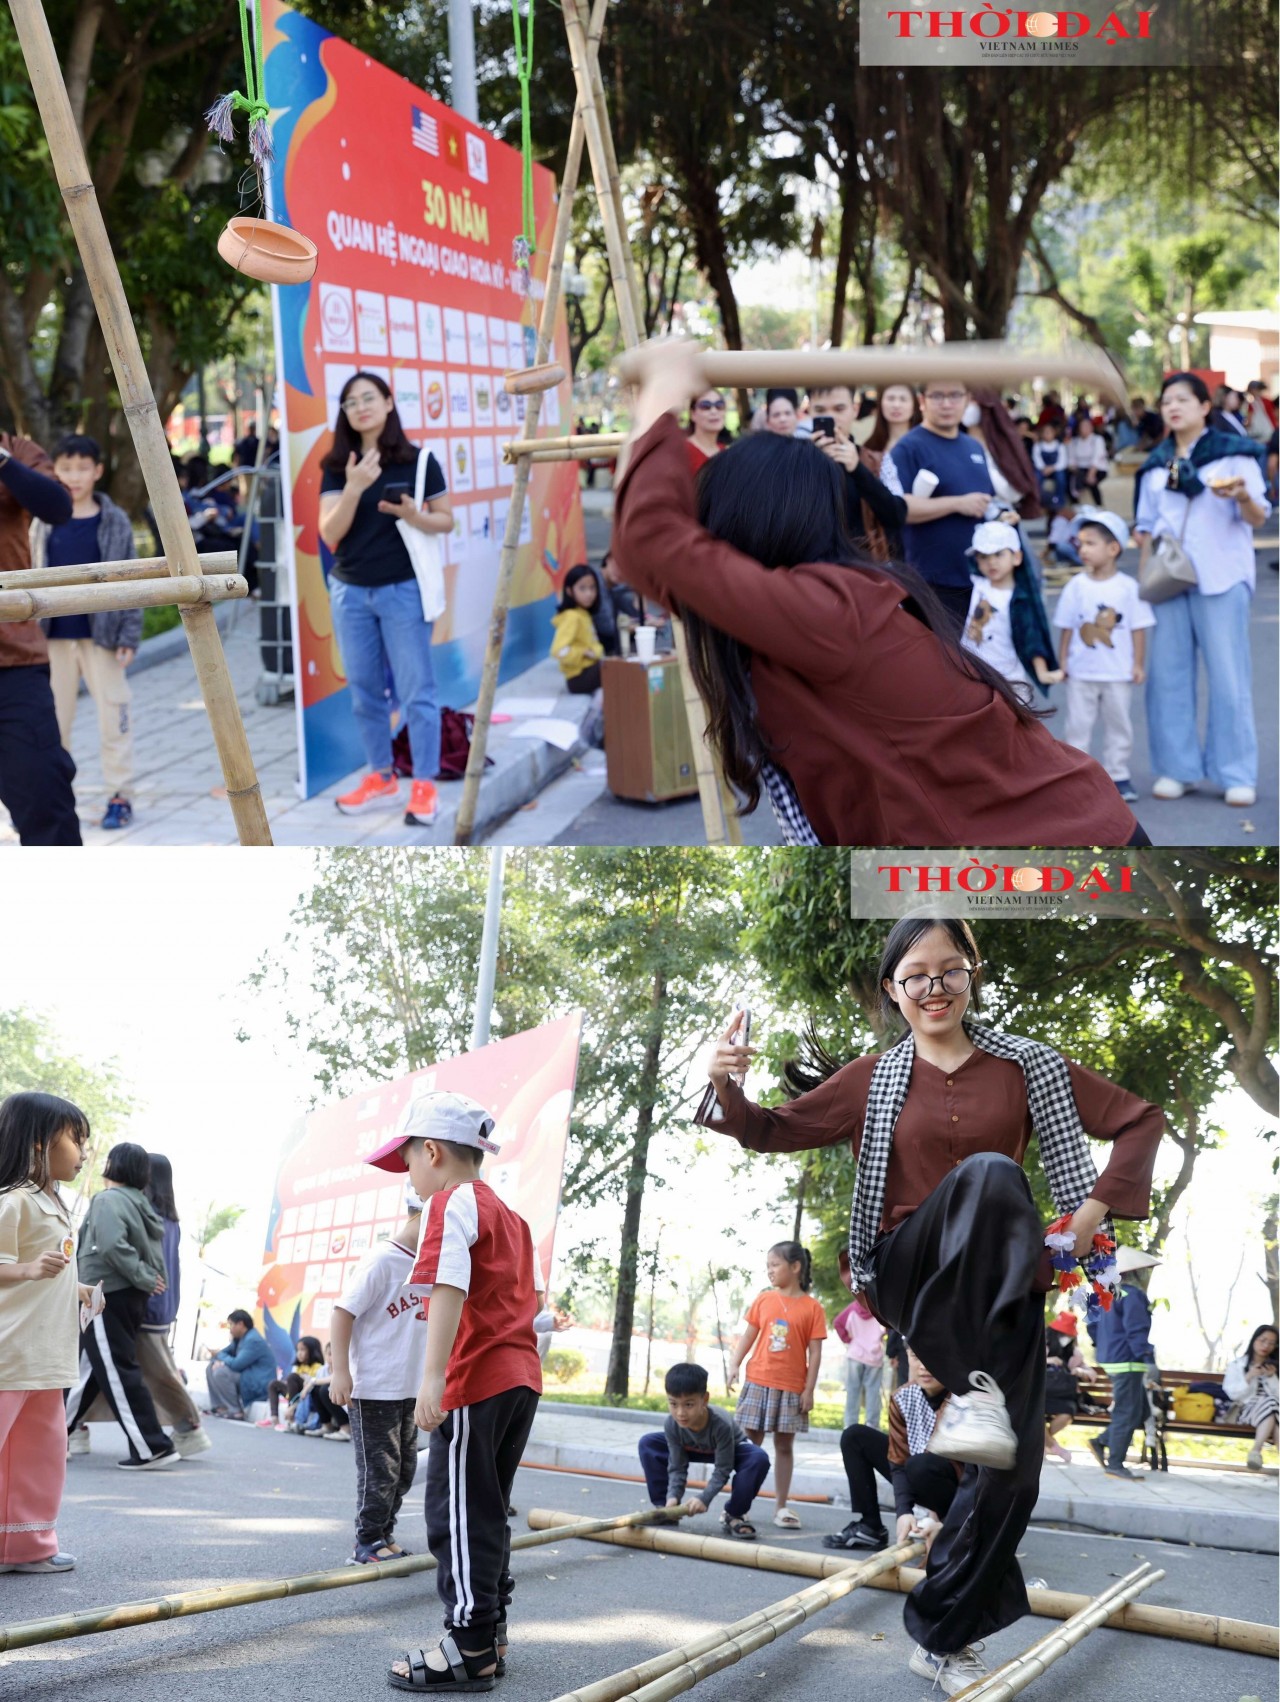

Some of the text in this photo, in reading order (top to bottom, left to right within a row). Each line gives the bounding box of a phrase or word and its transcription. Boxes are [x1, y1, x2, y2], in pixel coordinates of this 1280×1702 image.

[421, 178, 490, 246] 30 NĂM
[326, 210, 375, 252] QUAN
[375, 220, 398, 267] HỆ
[398, 231, 440, 277] NGOẠI
[440, 246, 469, 280] GIAO
[469, 255, 492, 286] HOA
[386, 1293, 423, 1319] BAS
